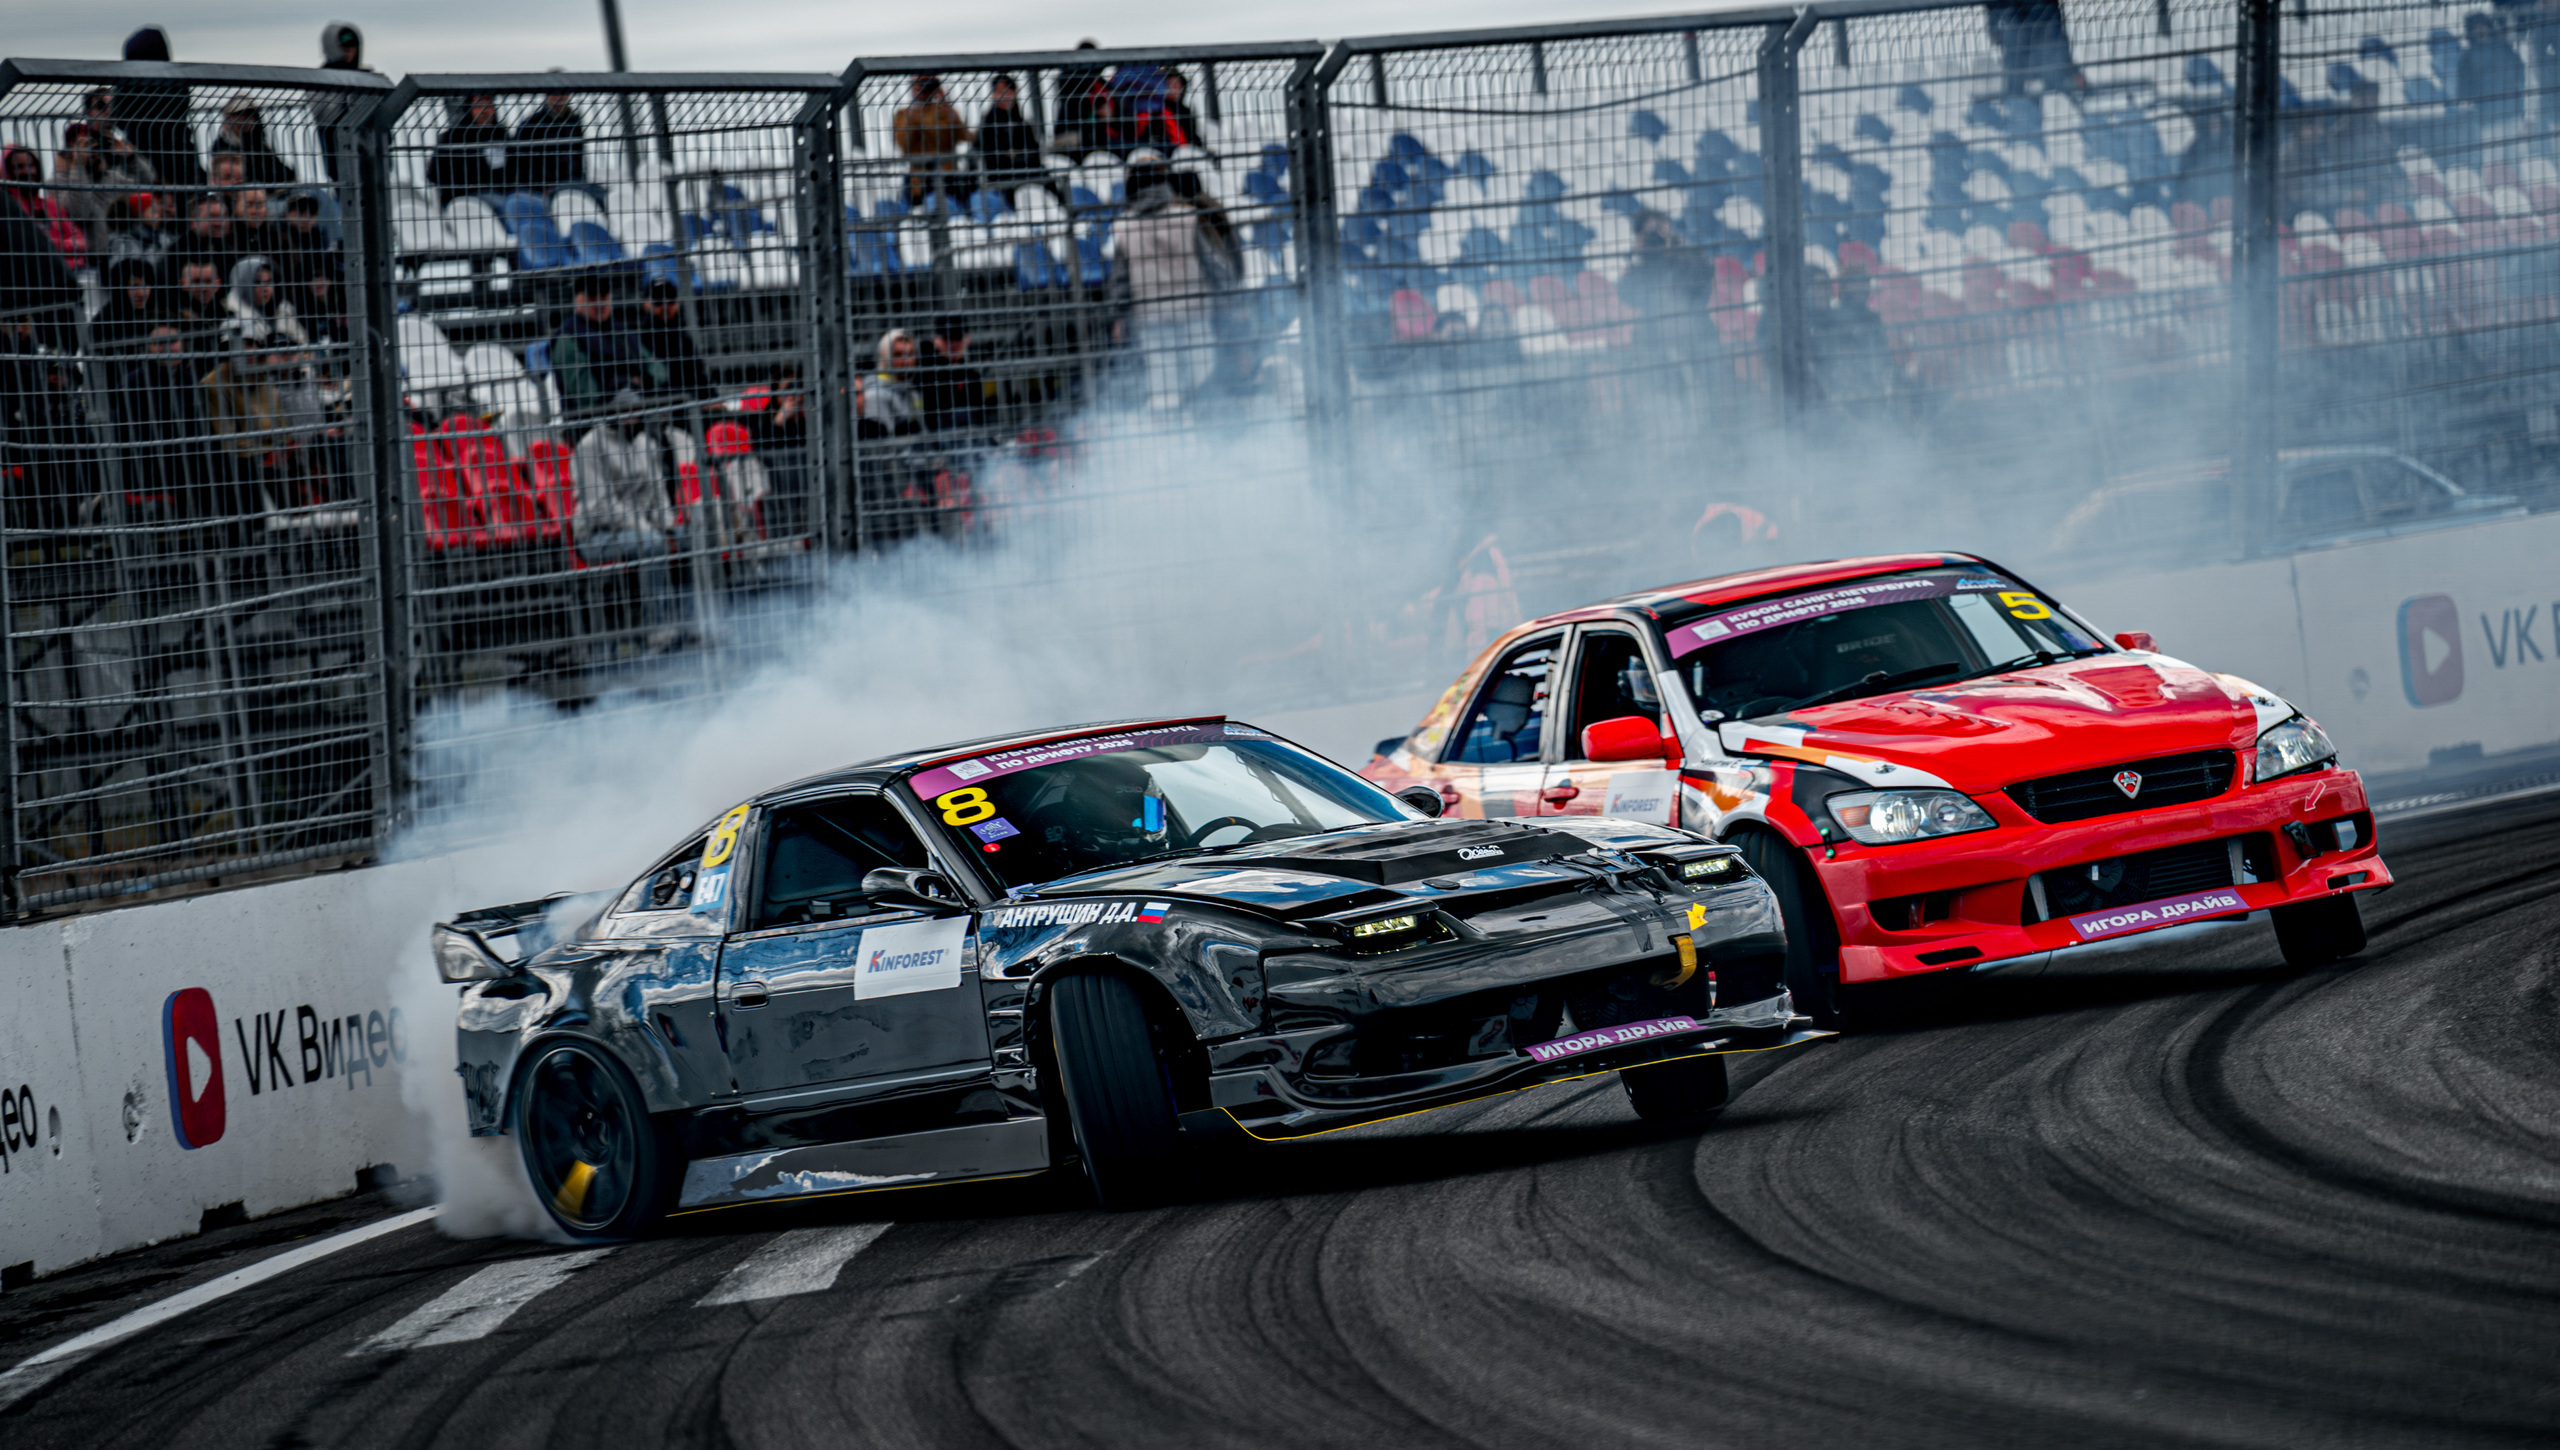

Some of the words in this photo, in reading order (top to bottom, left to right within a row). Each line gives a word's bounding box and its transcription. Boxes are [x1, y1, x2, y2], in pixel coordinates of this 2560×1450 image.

[1727, 604, 1782, 623] КУБОК
[1783, 580, 1935, 608] САНКТ-ПЕТЕРБУРГА
[1735, 621, 1761, 630] ПО
[1763, 603, 1826, 625] ДРИФТУ
[1828, 596, 1867, 608] 2026
[1998, 592, 2051, 619] 5
[2480, 603, 2544, 669] VK
[996, 759, 1024, 770] ПО
[1025, 745, 1092, 764] ДРИФТУ
[1094, 739, 1134, 750] 2026
[936, 787, 996, 826] 8
[703, 804, 750, 868] 8
[999, 903, 1105, 928] АНТРУШИН
[1098, 902, 1138, 925] Д.А.
[2082, 910, 2158, 934] ИГОРА
[2160, 895, 2237, 919] ДРАЙВ
[867, 949, 945, 973] KINFOREST
[235, 1009, 294, 1096] VK
[296, 1004, 408, 1091] Видео
[1536, 1033, 1613, 1059] ИГОРА
[0, 1083, 38, 1174] ео
